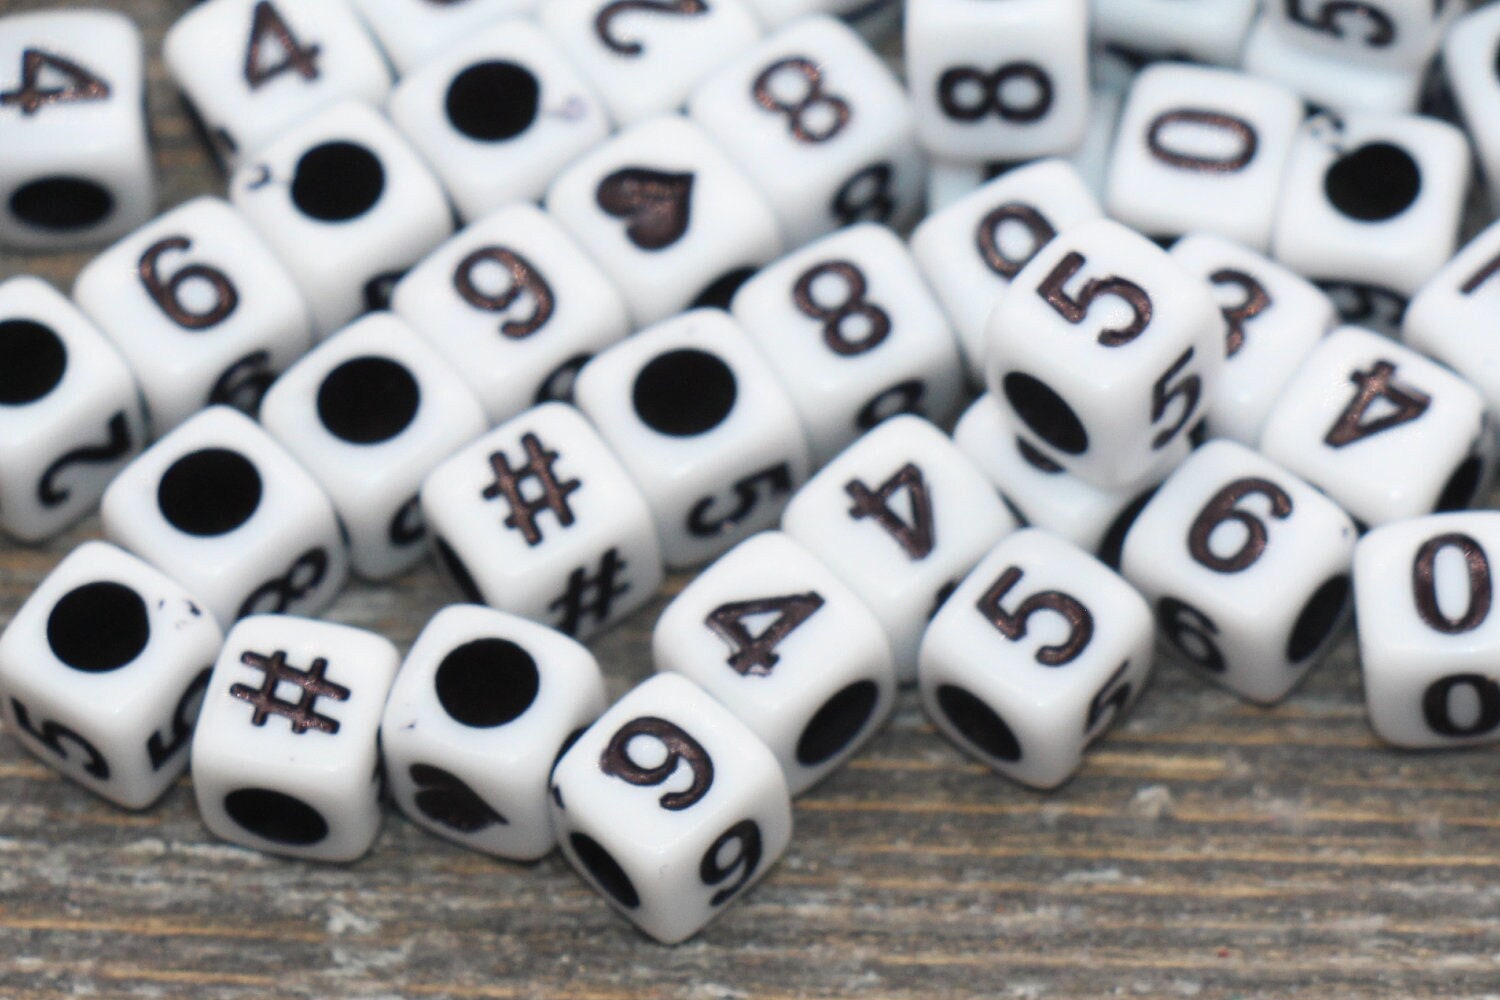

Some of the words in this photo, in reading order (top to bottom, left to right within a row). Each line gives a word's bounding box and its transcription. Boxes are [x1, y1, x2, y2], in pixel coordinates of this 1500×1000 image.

[0, 47, 111, 117] 4
[242, 0, 321, 90] 4
[751, 56, 851, 145] 8
[934, 59, 1057, 127] 8
[1145, 108, 1260, 173] 0
[791, 259, 893, 358] 8
[1031, 246, 1154, 349] 5
[1150, 345, 1200, 450] 5
[1323, 359, 1432, 450] 4
[480, 431, 583, 548] #
[843, 462, 937, 561] 4
[975, 565, 1096, 669] 5
[1411, 531, 1494, 636] 0
[704, 590, 826, 678] 4
[228, 649, 352, 736] #
[1422, 674, 1500, 736] 0
